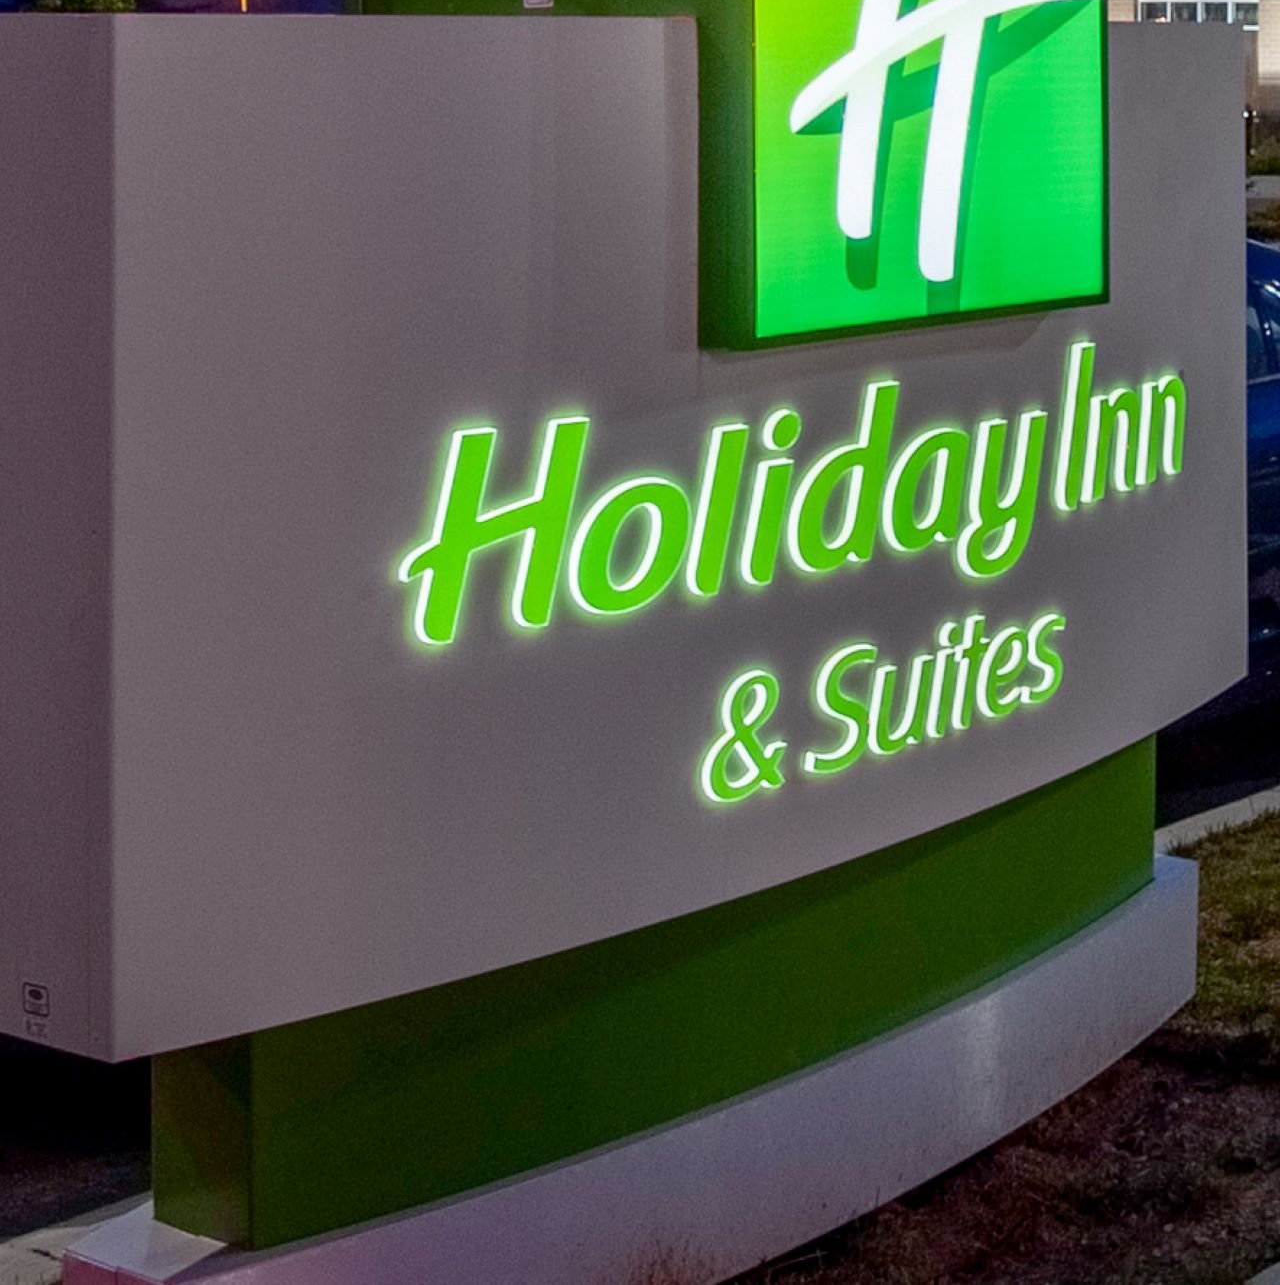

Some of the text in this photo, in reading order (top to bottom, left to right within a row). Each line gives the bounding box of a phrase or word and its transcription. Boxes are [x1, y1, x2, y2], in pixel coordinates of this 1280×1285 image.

[398, 341, 1185, 645] Holiday Inn
[700, 613, 1065, 803] & Suites
